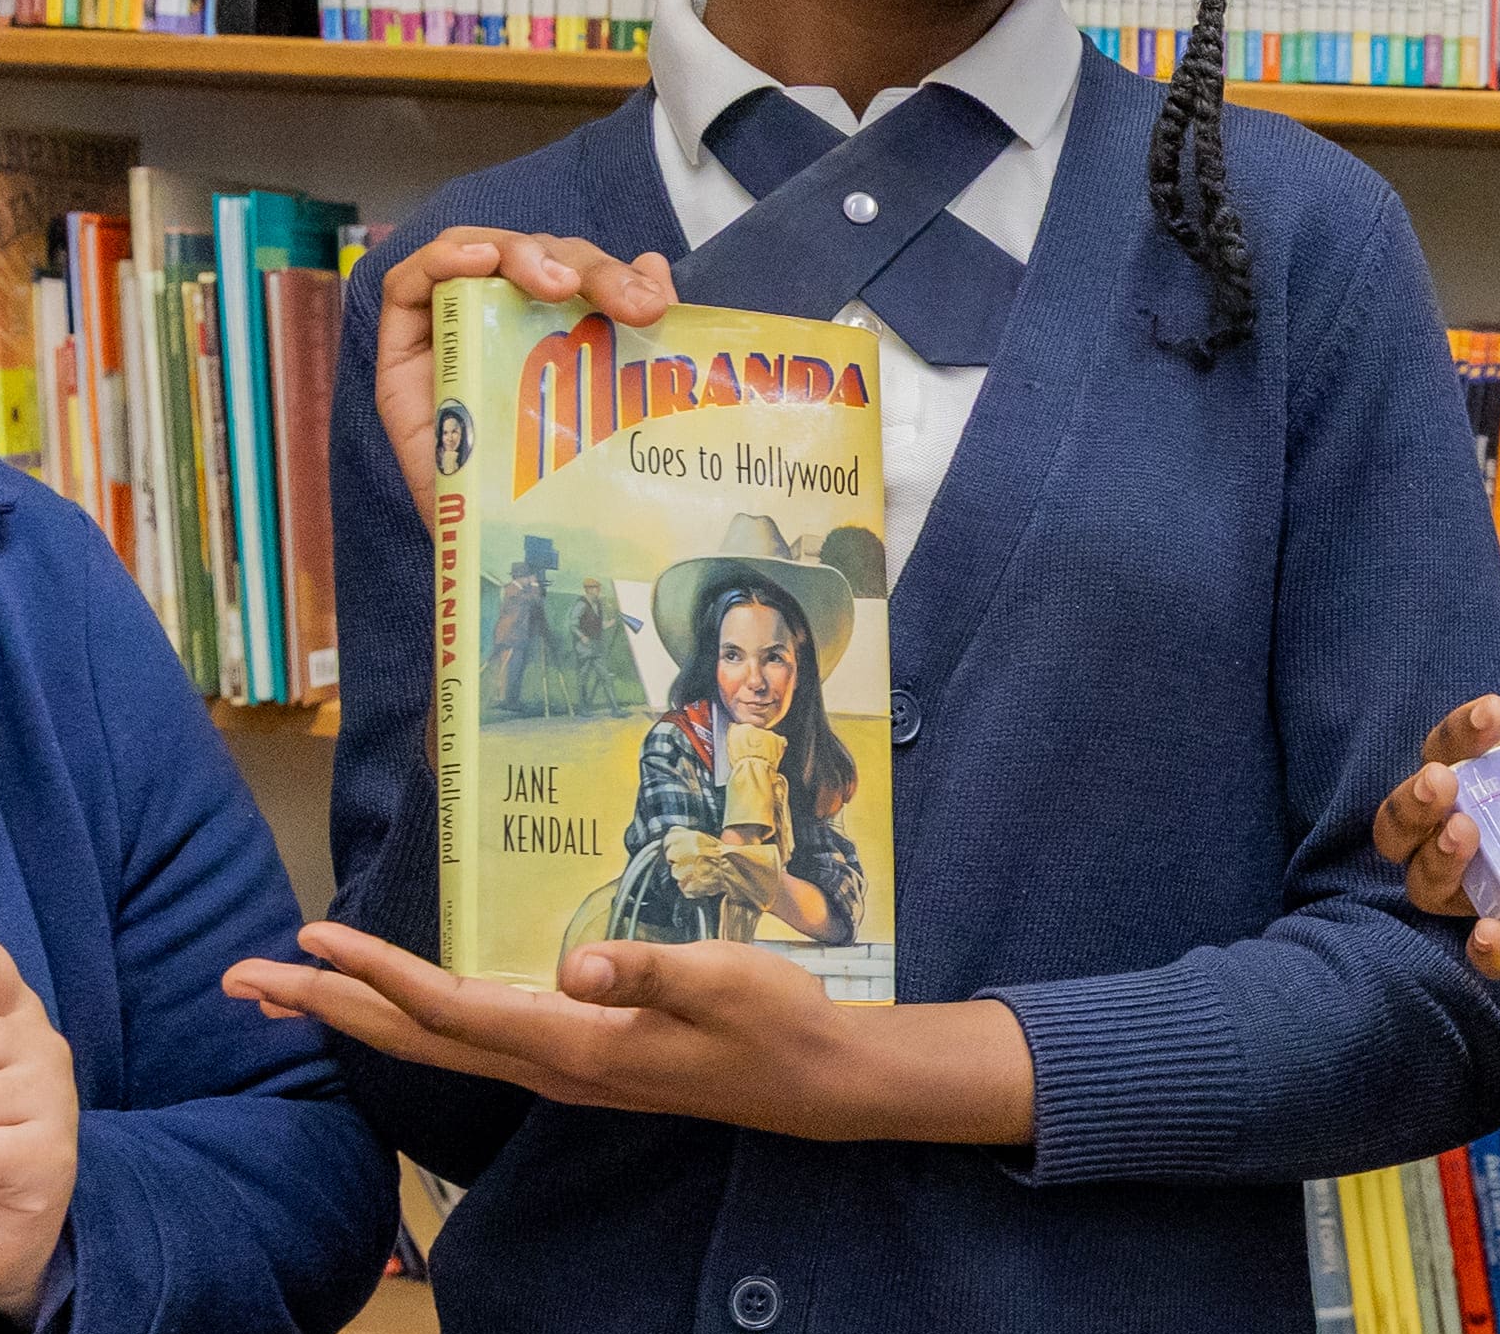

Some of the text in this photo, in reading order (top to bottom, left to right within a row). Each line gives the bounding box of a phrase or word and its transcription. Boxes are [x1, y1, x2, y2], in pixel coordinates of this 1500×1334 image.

[440, 296, 459, 385] JANE KENDALL
[513, 312, 870, 503] MIRANDA
[629, 430, 861, 499] Goes to Hollywood
[438, 492, 464, 866] MIRANDA Goes to Hollywood
[501, 764, 561, 804] JANE
[502, 813, 604, 858] KENDALL
